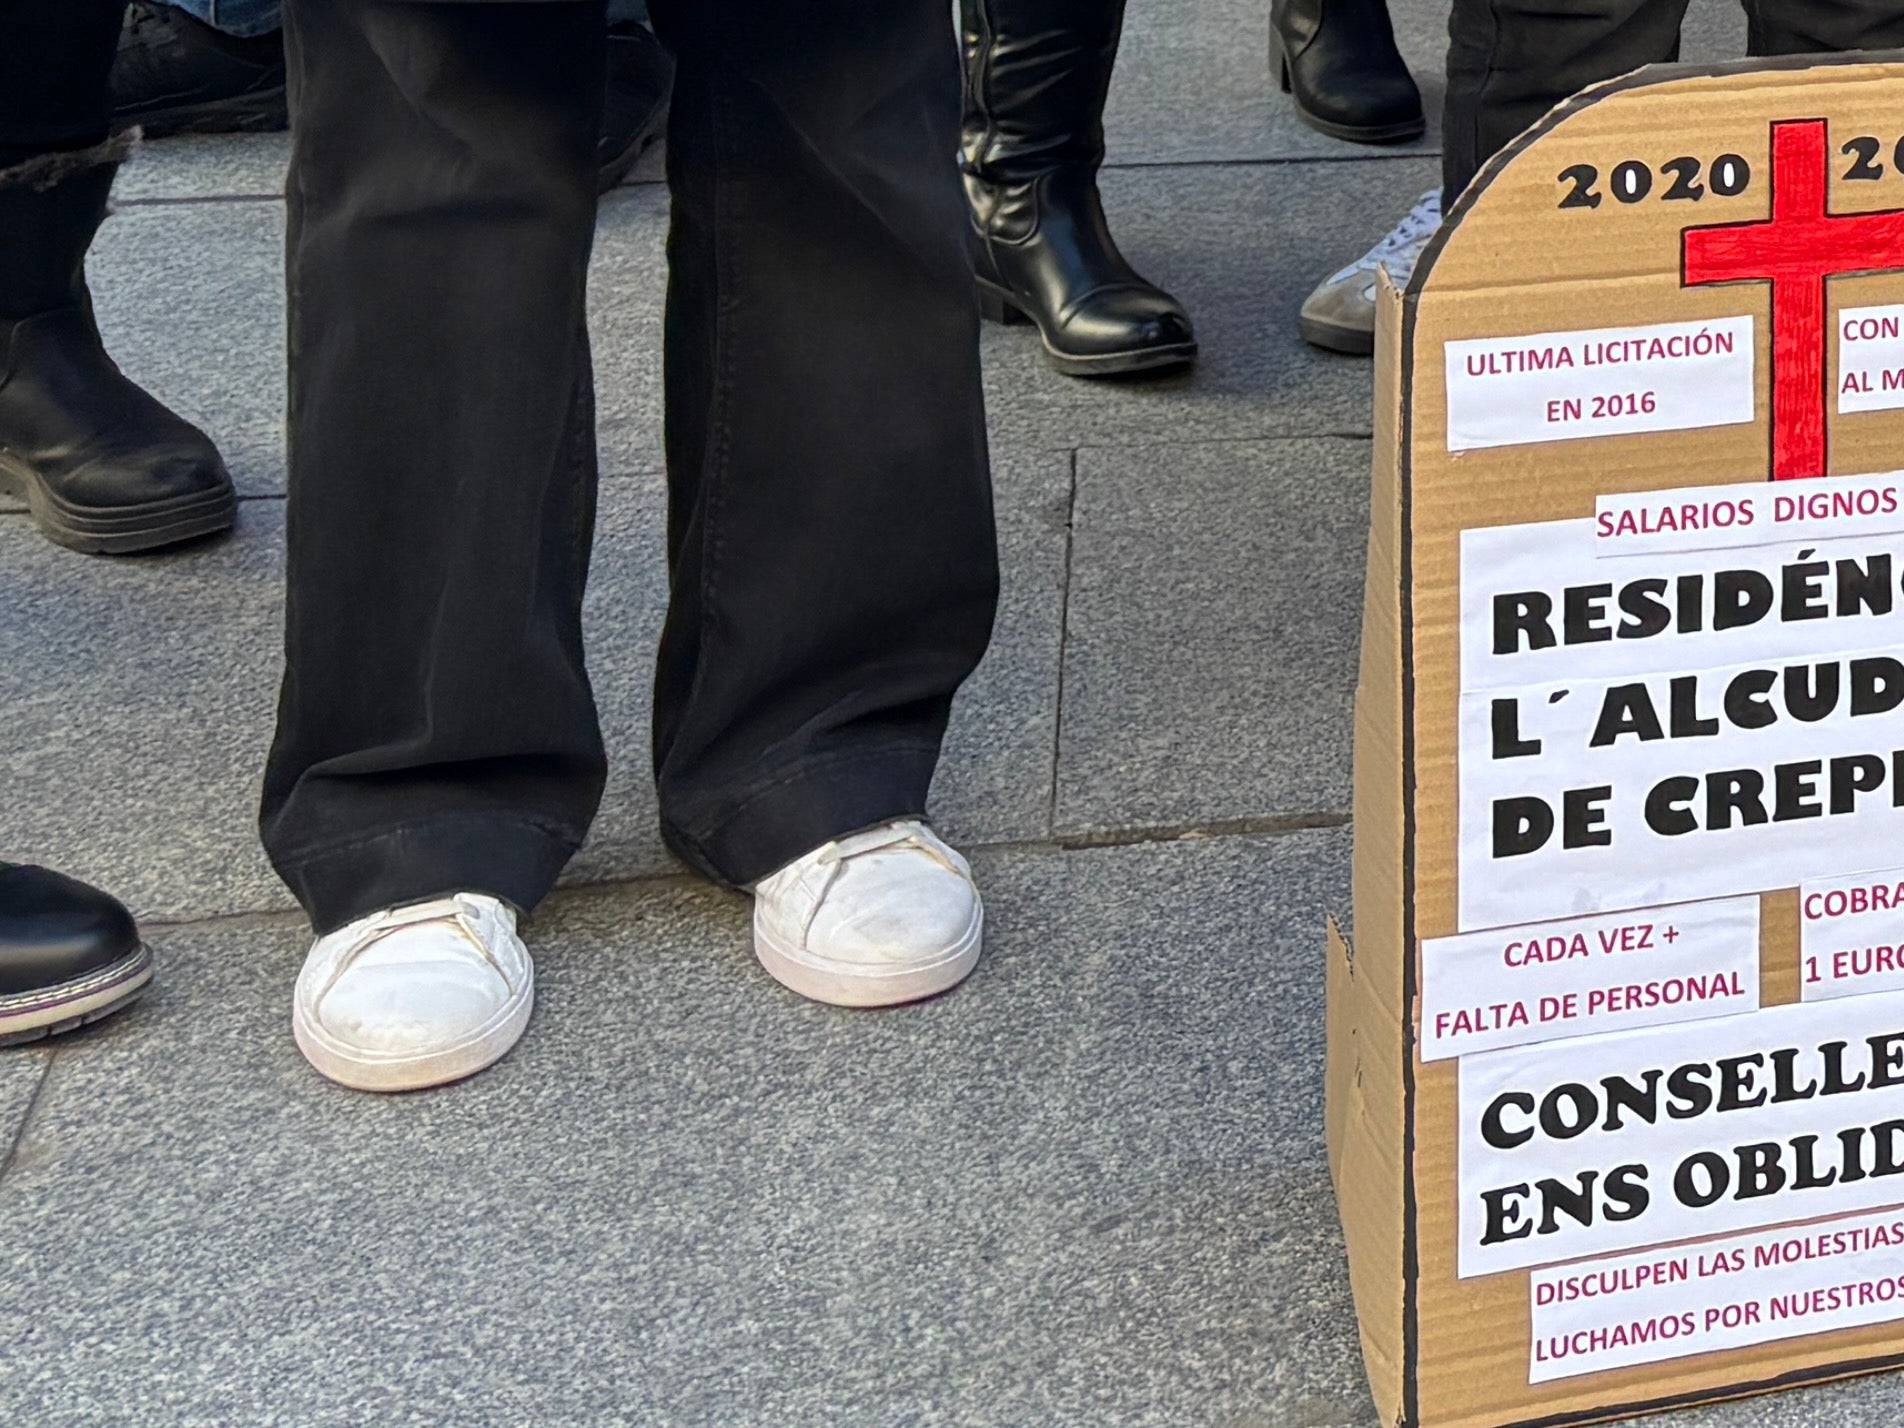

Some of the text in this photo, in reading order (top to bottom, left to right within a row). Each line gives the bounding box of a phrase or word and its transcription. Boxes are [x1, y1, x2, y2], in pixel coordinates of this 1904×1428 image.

[1558, 154, 1750, 208] 2020
[1844, 318, 1898, 340] CON
[1468, 333, 1732, 375] ULTIMA LICITACIÓN
[1548, 393, 1655, 421] EN 2016
[1843, 373, 1871, 392] AL
[1599, 501, 1753, 537] SALARIOS
[1776, 488, 1897, 521] DIGNOS
[1493, 786, 1611, 858] DE
[1505, 925, 1678, 966] CADA VEZ +
[1808, 958, 1820, 982] 1
[1437, 973, 1742, 1037] FALTA DE PERSONAL
[1480, 1164, 1649, 1245] ENS
[1537, 1261, 1687, 1305] DISCULPEN
[1699, 1251, 1744, 1276] LAS
[1755, 1224, 1904, 1266] MOLESTIAS
[1538, 1313, 1695, 1361] LUCHAMOS
[1706, 1302, 1759, 1330] POR
